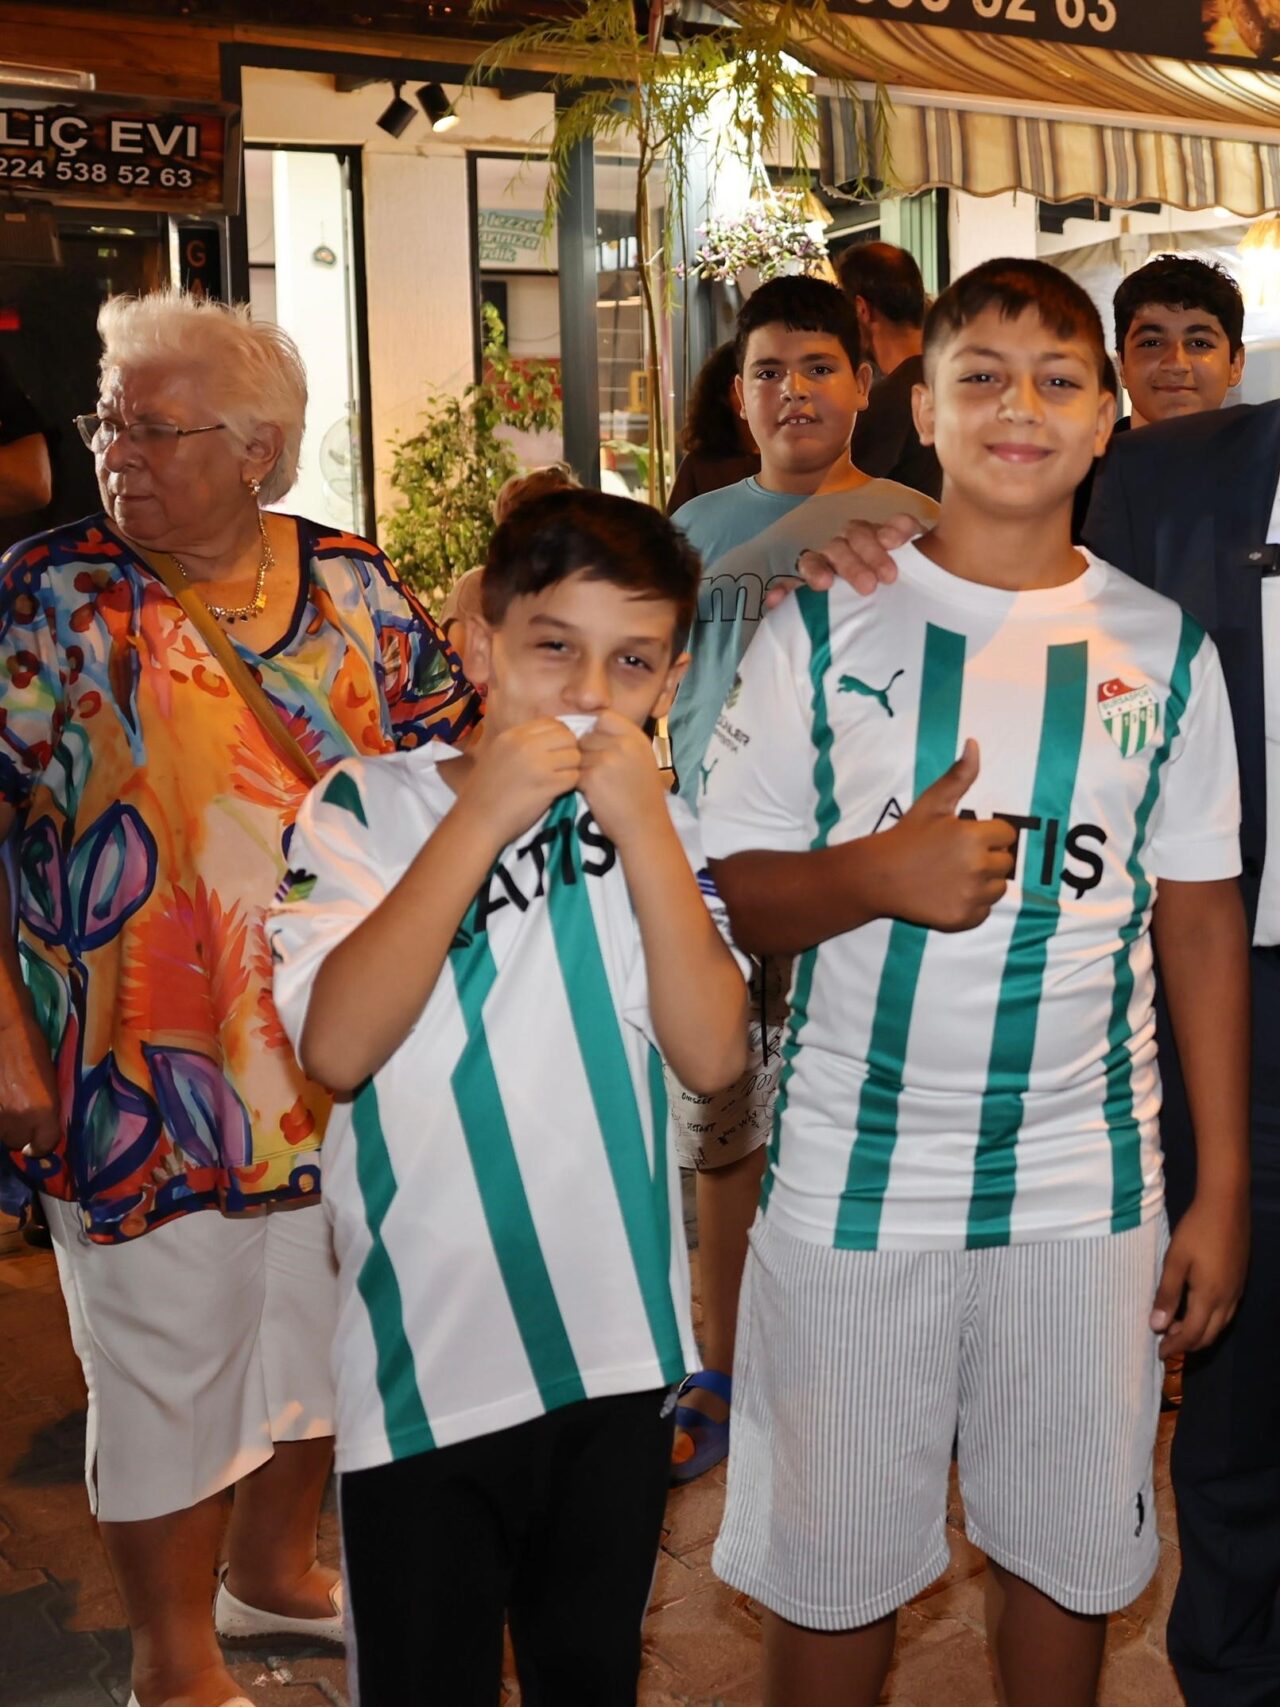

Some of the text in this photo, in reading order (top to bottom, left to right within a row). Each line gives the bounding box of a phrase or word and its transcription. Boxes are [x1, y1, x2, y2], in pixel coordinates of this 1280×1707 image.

[56, 161, 107, 183] 538
[118, 165, 150, 185] 52
[160, 168, 192, 188] 63
[958, 808, 1108, 900] TIŞ
